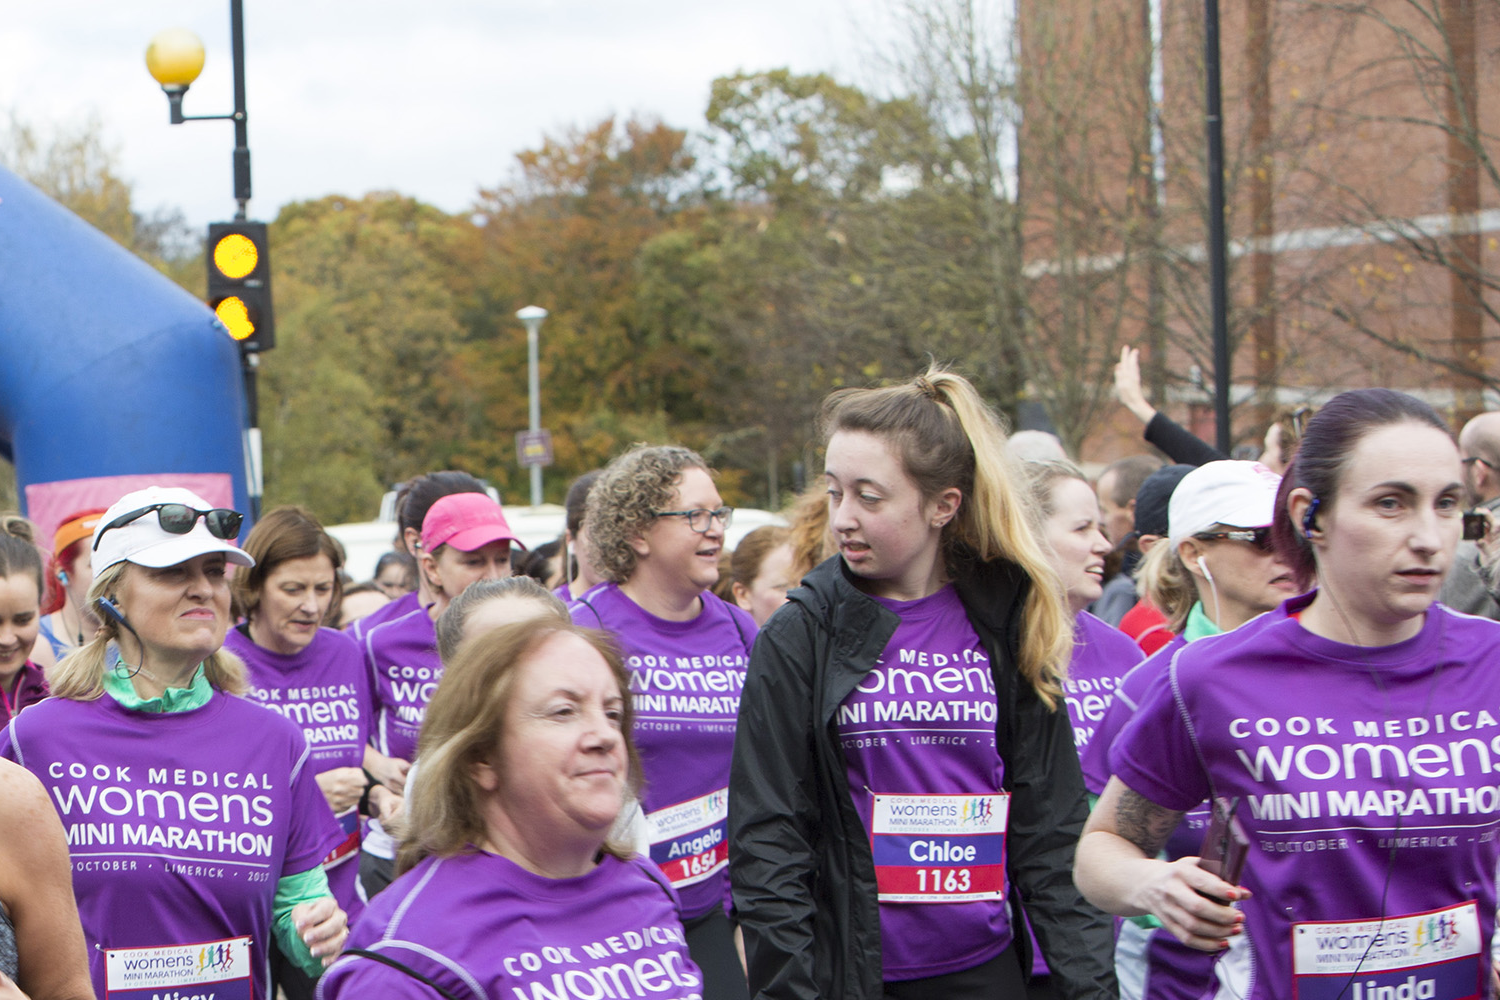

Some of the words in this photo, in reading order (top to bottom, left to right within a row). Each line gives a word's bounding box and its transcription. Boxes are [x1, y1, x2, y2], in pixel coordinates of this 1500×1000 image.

[622, 655, 670, 668] OOK
[900, 648, 987, 667] MEDICA
[388, 665, 444, 680] COOK
[856, 667, 996, 695] omen
[287, 683, 357, 700] MEDICAL
[1061, 676, 1122, 694] EDIC
[261, 698, 360, 724] mens
[395, 705, 426, 722] MIN
[670, 695, 741, 713] MARATH
[836, 702, 867, 725] INI
[633, 722, 682, 731] OCTOBER
[698, 724, 737, 733] LIMERIC
[1229, 716, 1339, 738] COOK
[1352, 709, 1499, 738] MEDICA
[303, 724, 358, 743] RATHO
[911, 735, 967, 746] LIMERICK
[49, 762, 132, 782] COOK
[148, 768, 273, 789] MEDICAL
[52, 785, 274, 826] womens
[890, 805, 957, 816] womens
[1247, 791, 1321, 821] MINI
[656, 807, 701, 828] womens
[909, 818, 957, 826] MARATHON
[64, 823, 115, 845] MINI
[122, 823, 273, 857] MARATHON
[668, 828, 723, 858] Angela
[1275, 838, 1349, 853] OCTOBER
[1378, 835, 1458, 848] LIMERICK
[909, 840, 977, 862] Chloe
[77, 861, 138, 871] OCTOBER
[164, 863, 225, 878] LIMERICK
[247, 871, 270, 882] 2017
[680, 850, 717, 877] 1654
[916, 868, 971, 892] 1163
[154, 948, 193, 956] MEDICAL
[503, 945, 581, 977] COOK
[581, 926, 688, 960] MEDICAL
[124, 955, 194, 970] womens
[124, 973, 142, 981] MINI
[144, 968, 194, 979] MARATHON
